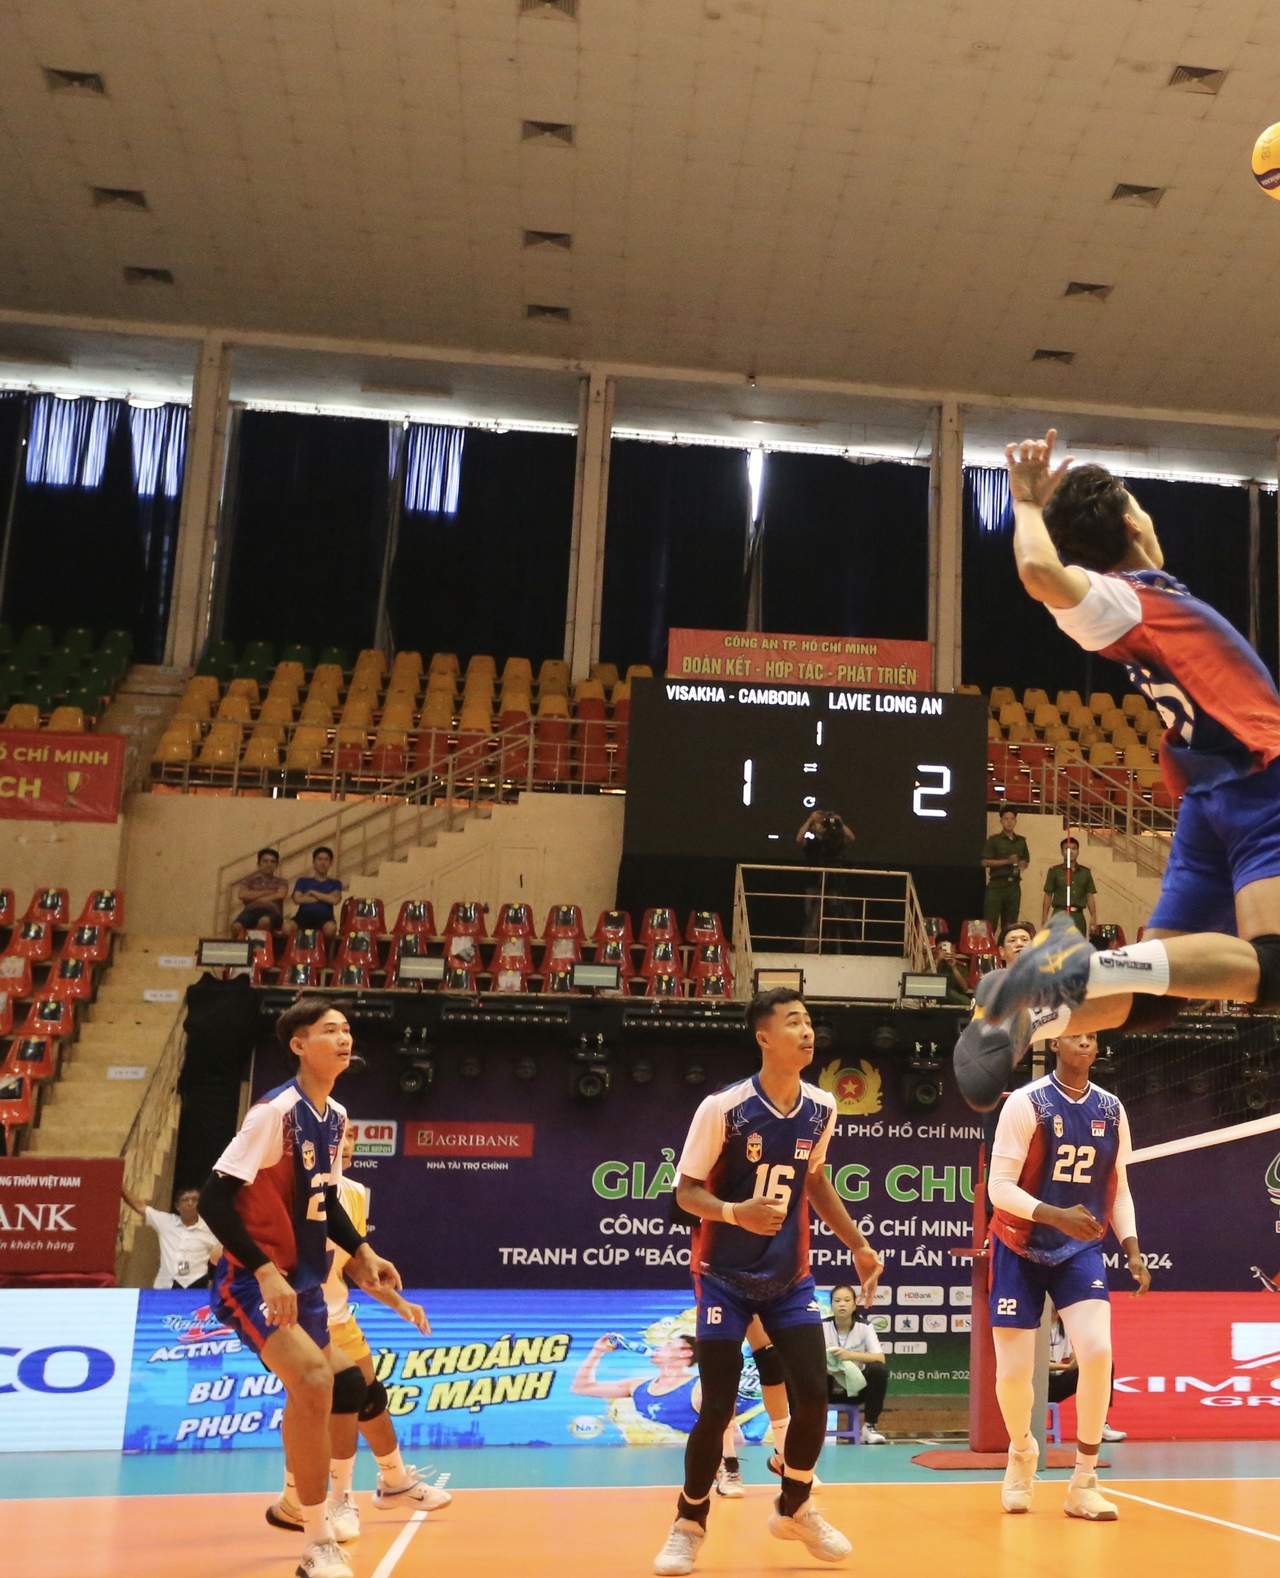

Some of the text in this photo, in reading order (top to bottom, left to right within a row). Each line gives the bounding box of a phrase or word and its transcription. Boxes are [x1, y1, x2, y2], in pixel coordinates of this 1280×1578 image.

[724, 635, 757, 649] CÔNG
[761, 638, 779, 650] AN
[782, 640, 798, 651] TP.
[821, 641, 841, 653] CHÍ
[845, 643, 878, 656] MINH
[682, 653, 721, 675] ĐOÀN
[725, 653, 751, 677] KẾT
[765, 659, 793, 682] HỢP
[798, 660, 824, 680] TÁC
[837, 662, 873, 682] PHÁT
[877, 661, 917, 685] TRIỂN
[666, 685, 726, 702] VISAKHA
[739, 688, 810, 707] CAMBODIA
[829, 692, 942, 715] LAVIE LONG AN
[13, 745, 51, 762] CHÍ
[54, 749, 109, 765] MINH
[742, 758, 753, 807] 1
[912, 764, 951, 818] 2
[435, 1134, 519, 1147] AGRIBANK
[848, 1121, 883, 1138] PHỐ
[888, 1121, 913, 1138] HỒ
[917, 1124, 946, 1139] CHÍ
[427, 1159, 509, 1171] NHÀ TÀI TRỢ CHÍNH
[1052, 1144, 1096, 1184] 22
[13, 1174, 38, 1187] THÔN
[39, 1175, 59, 1189] VIỆT
[60, 1177, 81, 1187] NAM
[752, 1163, 796, 1214] 16
[599, 1213, 664, 1235] CÔNG
[879, 1216, 917, 1236] CHÍ
[499, 1247, 577, 1265] TRANH
[583, 1244, 630, 1265] CÚP
[901, 1245, 943, 1266] LẦN
[706, 1306, 723, 1325] 16
[997, 1298, 1017, 1316] 22
[148, 1339, 243, 1363] ACTIVE
[188, 1375, 235, 1405] BÙ
[401, 1333, 571, 1380] KHOÁNG
[918, 1371, 925, 1379] 8
[927, 1371, 950, 1380] năm
[175, 1410, 263, 1442] PHỤC
[426, 1371, 555, 1413] MẠNH
